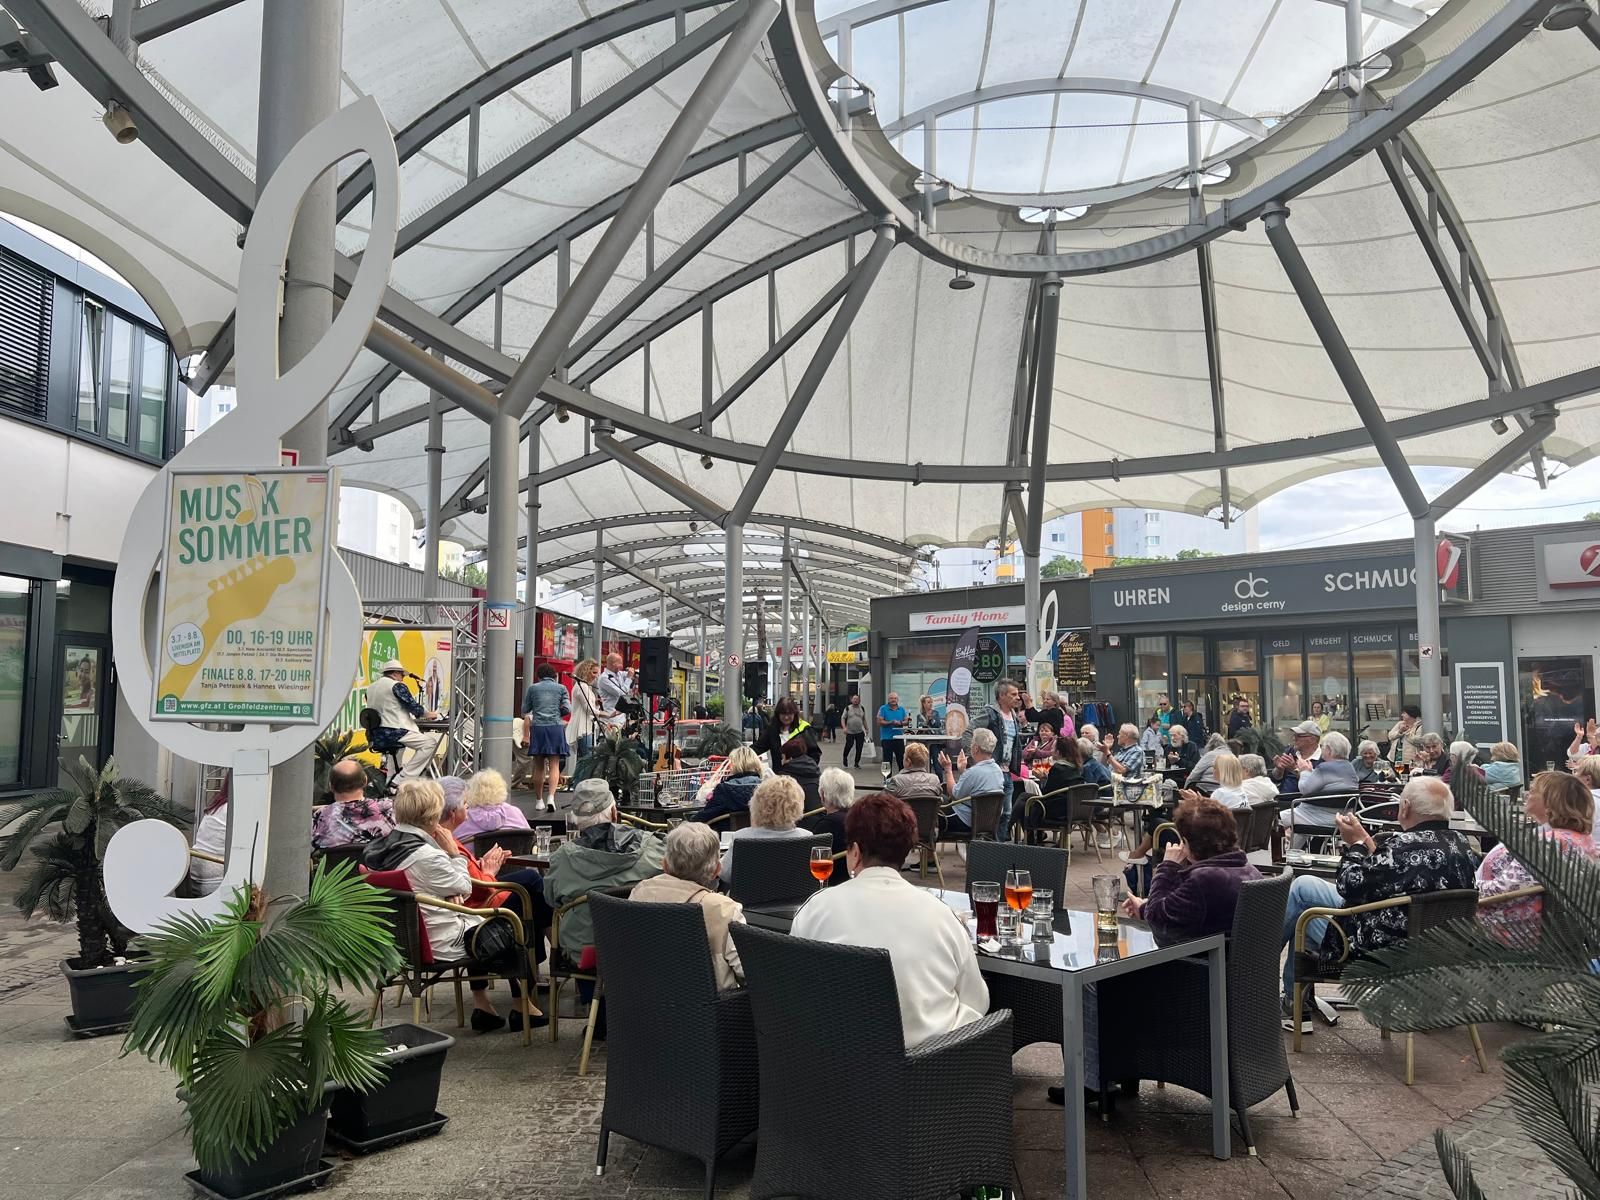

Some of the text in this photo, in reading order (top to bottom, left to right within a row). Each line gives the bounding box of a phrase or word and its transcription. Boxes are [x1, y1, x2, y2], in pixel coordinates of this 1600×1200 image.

[178, 517, 312, 564] SOMMER
[1324, 567, 1416, 592] SCHMU
[1113, 587, 1170, 607] UHREN
[1221, 599, 1286, 613] design cerny
[925, 610, 1009, 625] Family Home
[227, 630, 313, 646] DO, 16-19 UHR
[1272, 640, 1290, 648] GELD
[1310, 636, 1342, 646] VERGEHT
[1353, 634, 1393, 644] SCHMUCK
[202, 668, 311, 682] FINALE 8.8. 17-20 UHR
